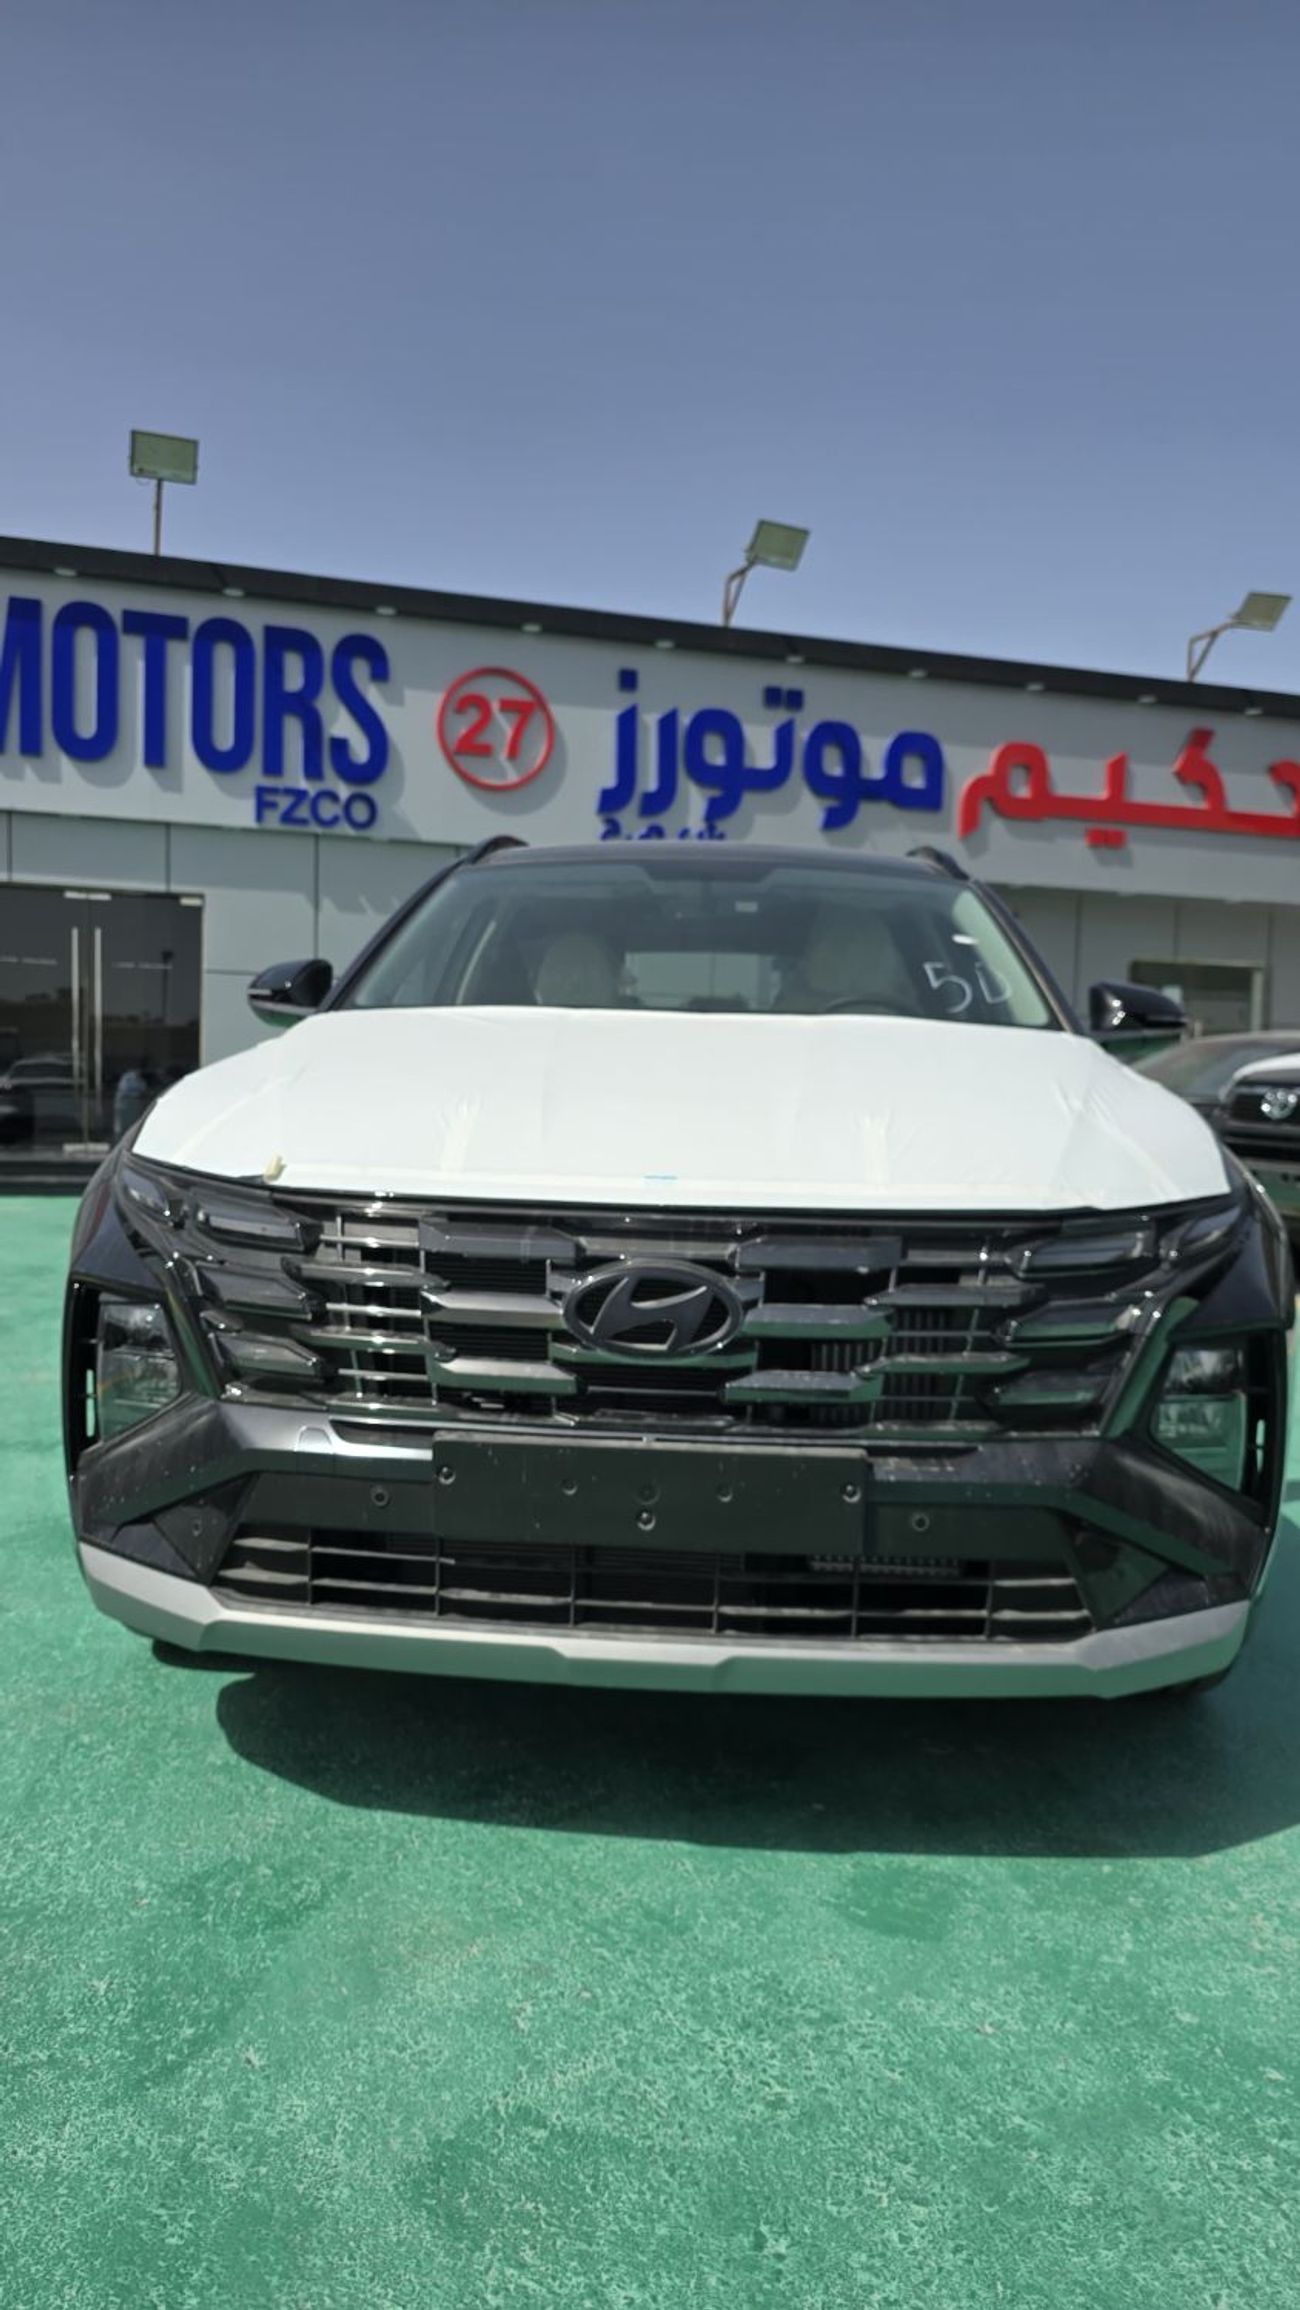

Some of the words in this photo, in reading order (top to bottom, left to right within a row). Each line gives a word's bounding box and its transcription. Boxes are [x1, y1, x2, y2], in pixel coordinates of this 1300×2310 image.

[453, 692, 540, 761] 27
[596, 668, 944, 832] موتورز
[255, 784, 377, 831] FZCO
